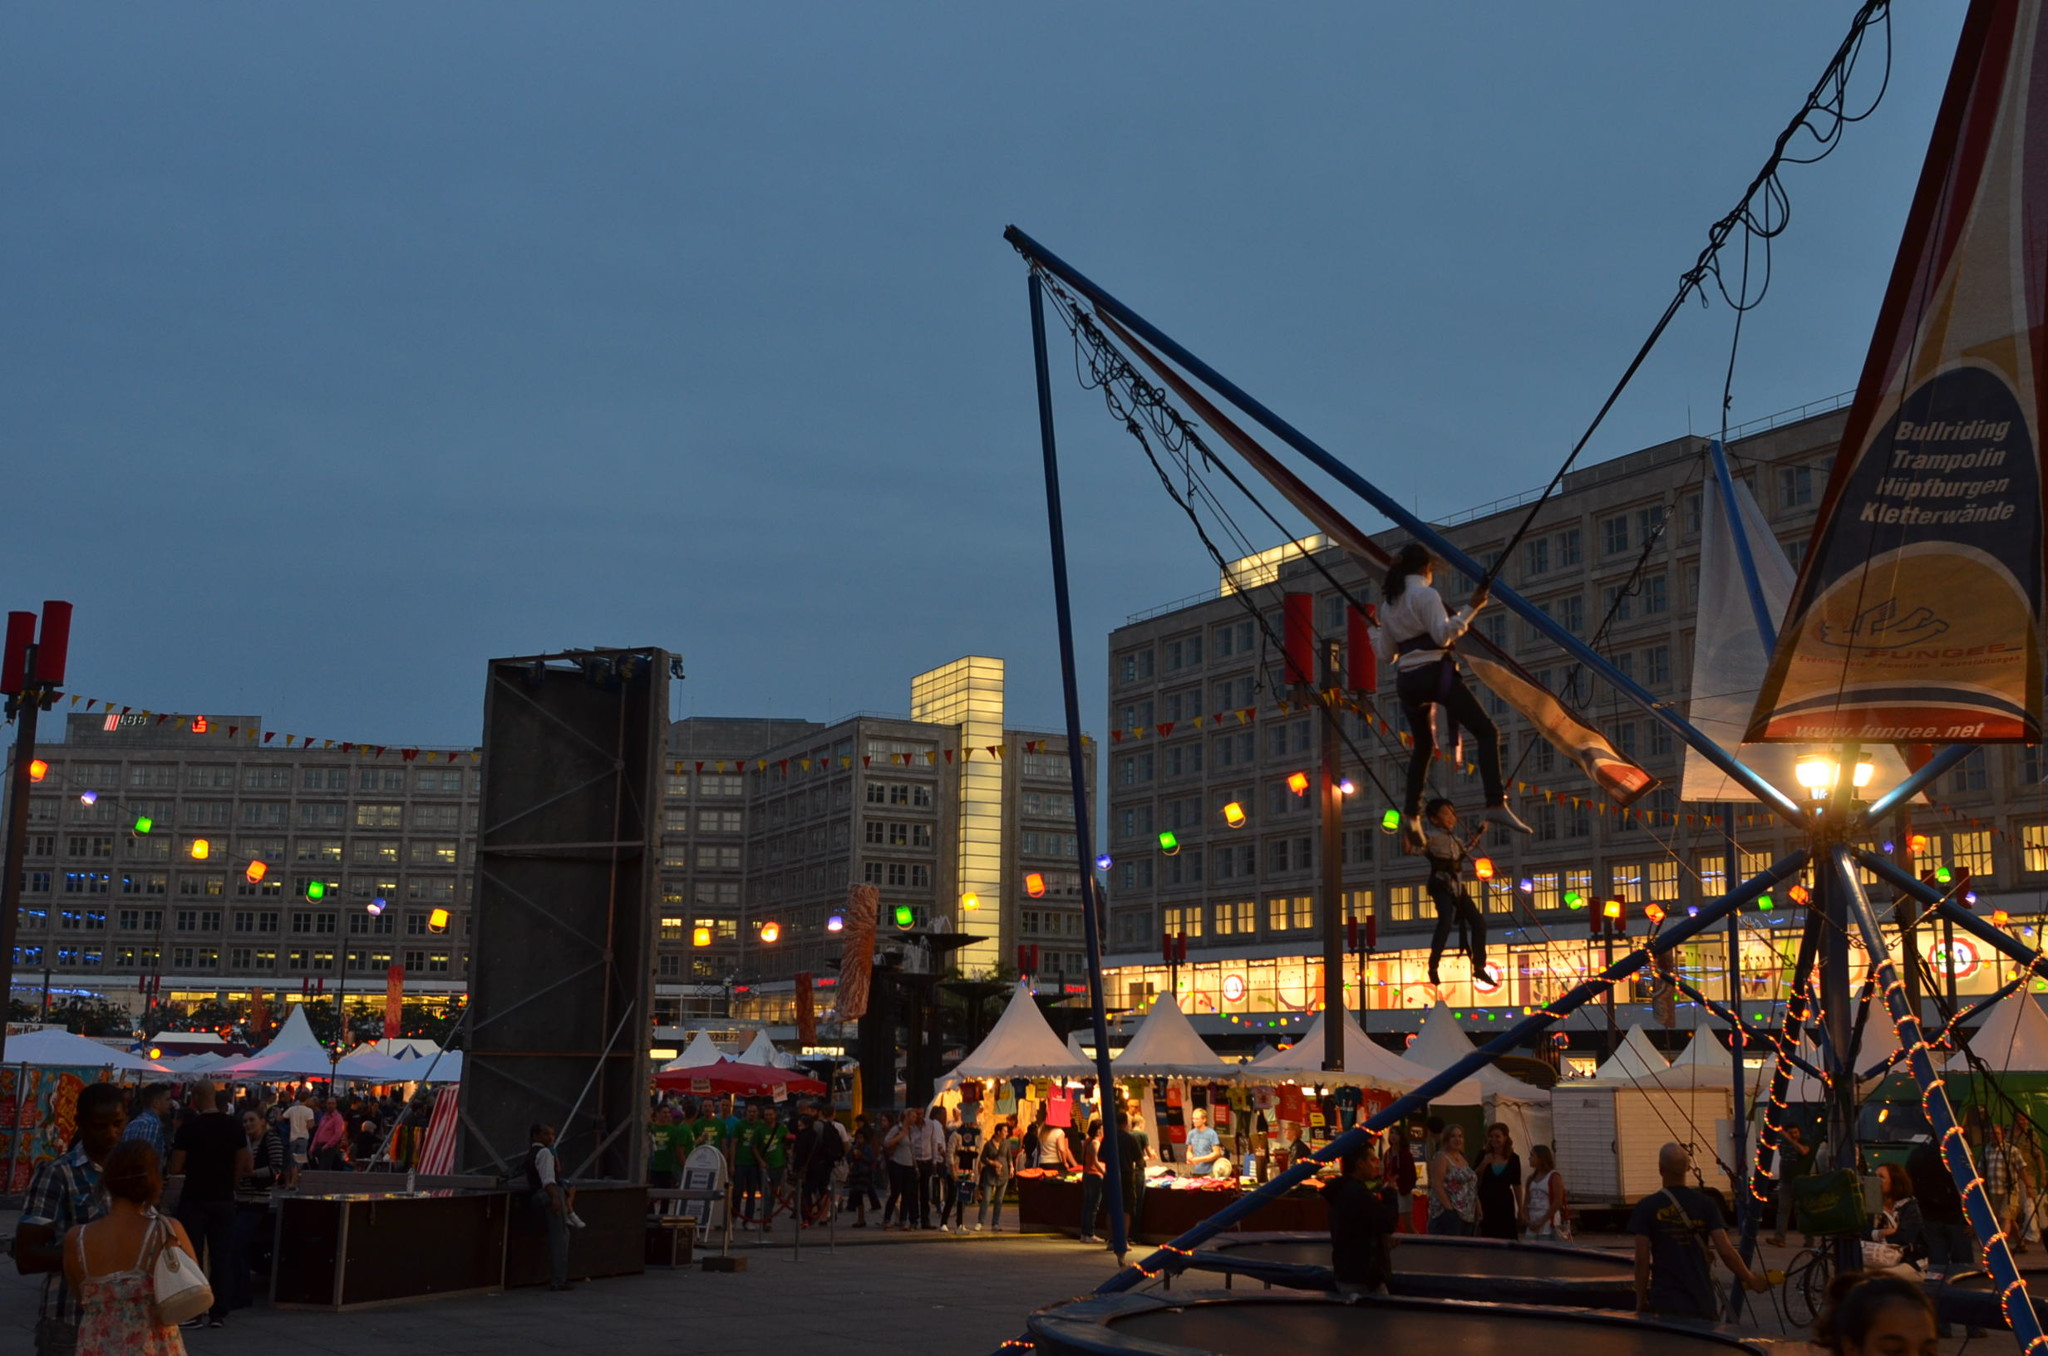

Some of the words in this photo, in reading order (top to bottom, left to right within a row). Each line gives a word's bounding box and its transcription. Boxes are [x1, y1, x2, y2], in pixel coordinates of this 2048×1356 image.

[1894, 419, 2011, 442] Bullriding
[1892, 447, 2006, 473] Trampolin
[1875, 476, 2010, 501] Hüpfburgen
[1860, 500, 2015, 525] Kletterwände
[1866, 643, 2007, 660] FUNGEE
[1794, 722, 1985, 740] www.fungee.net
